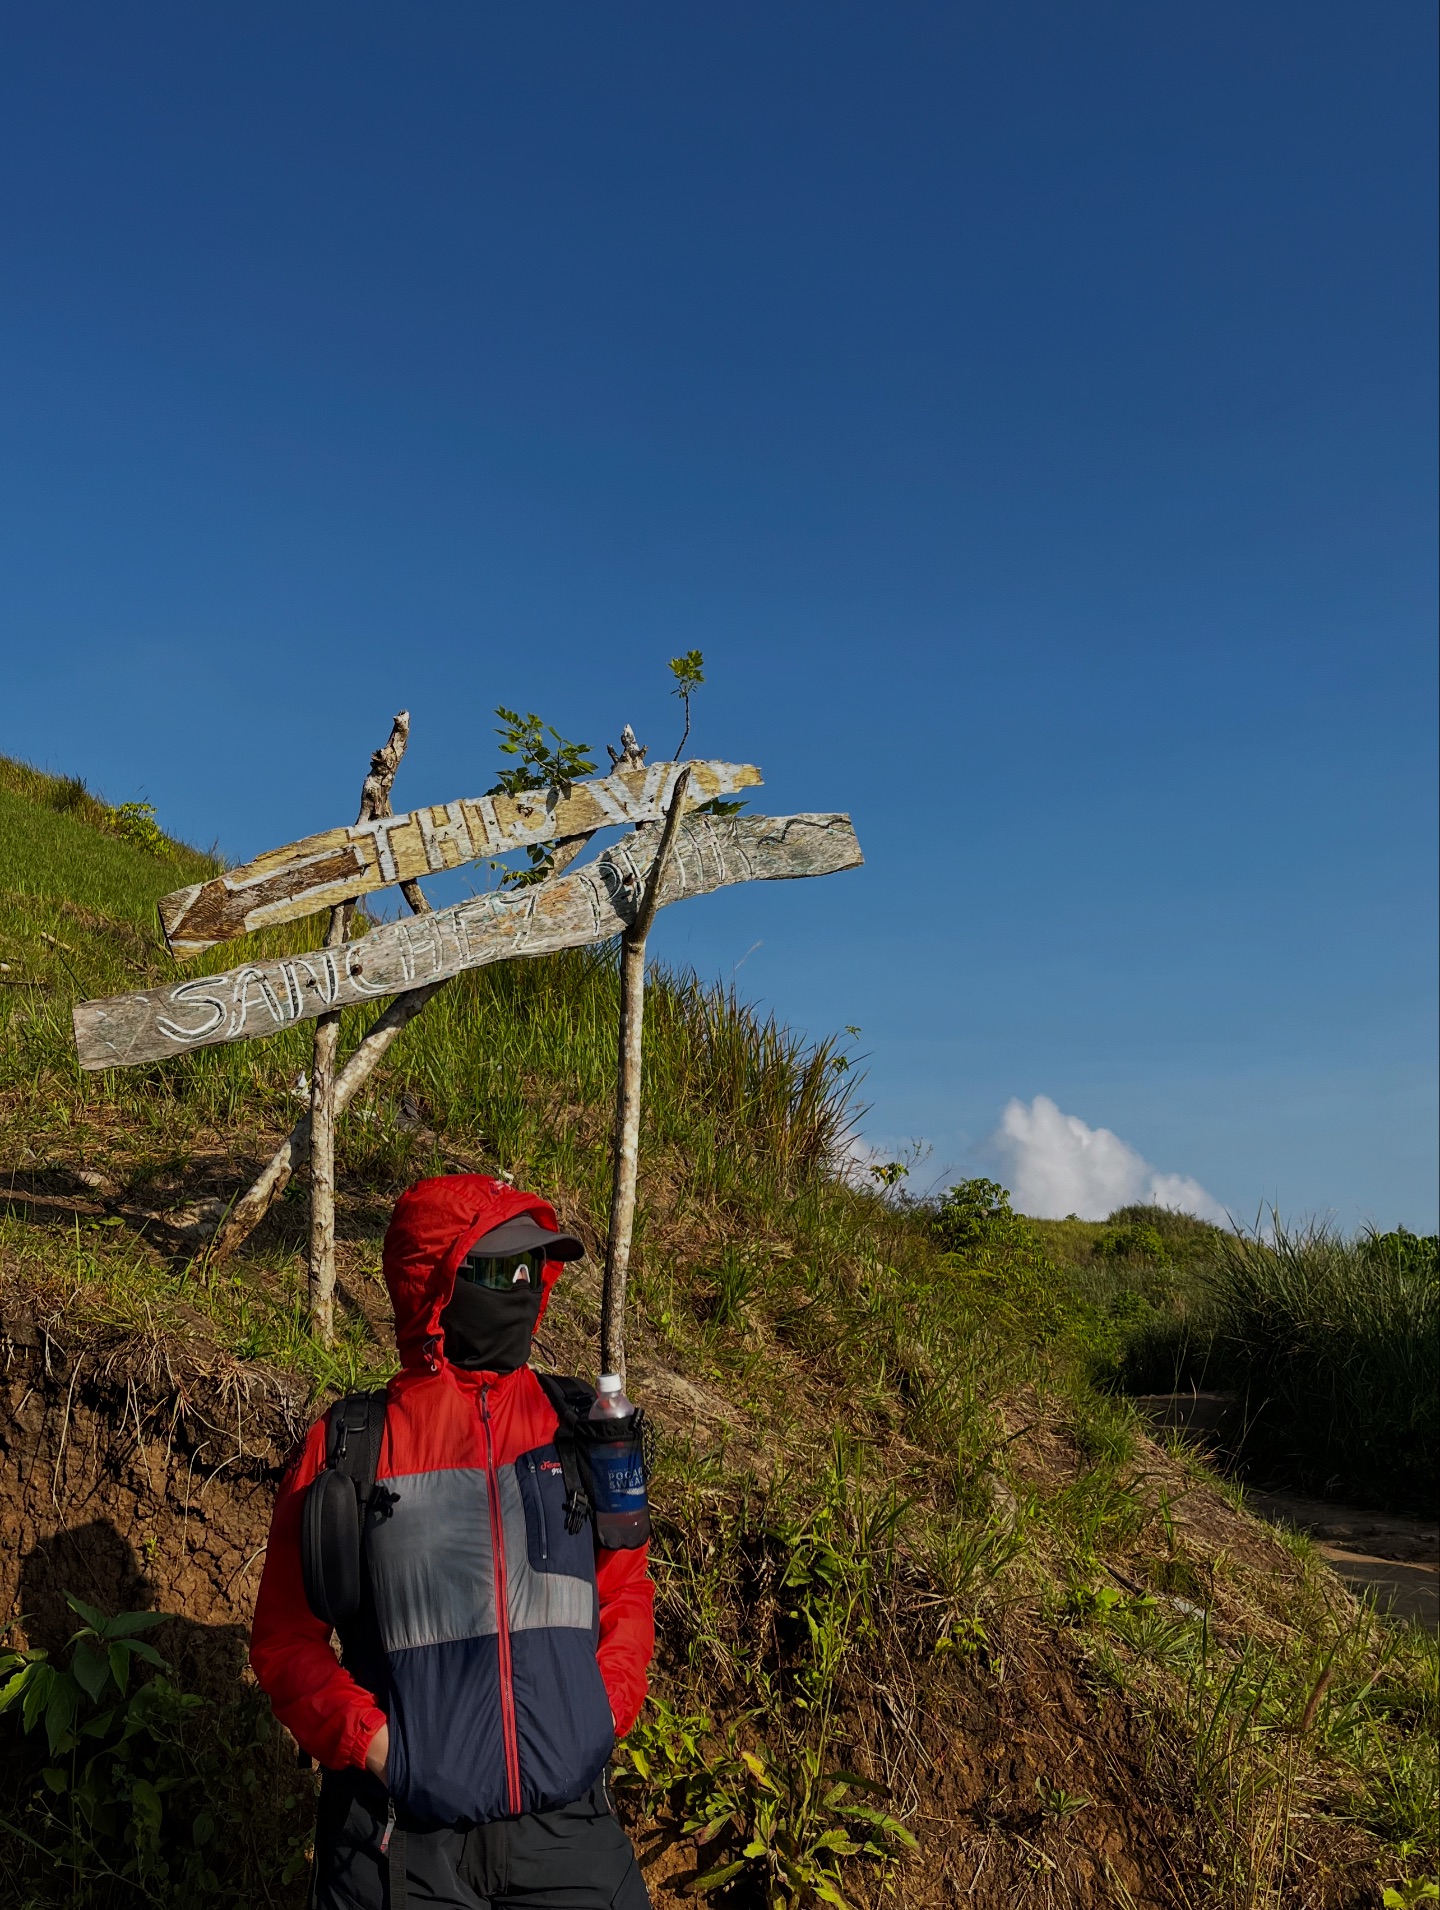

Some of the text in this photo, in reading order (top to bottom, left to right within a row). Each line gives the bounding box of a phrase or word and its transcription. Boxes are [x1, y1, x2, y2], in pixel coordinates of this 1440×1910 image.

[347, 788, 558, 883] THIS
[156, 879, 552, 1043] SANCHEZ
[608, 1466, 643, 1481] POCAR
